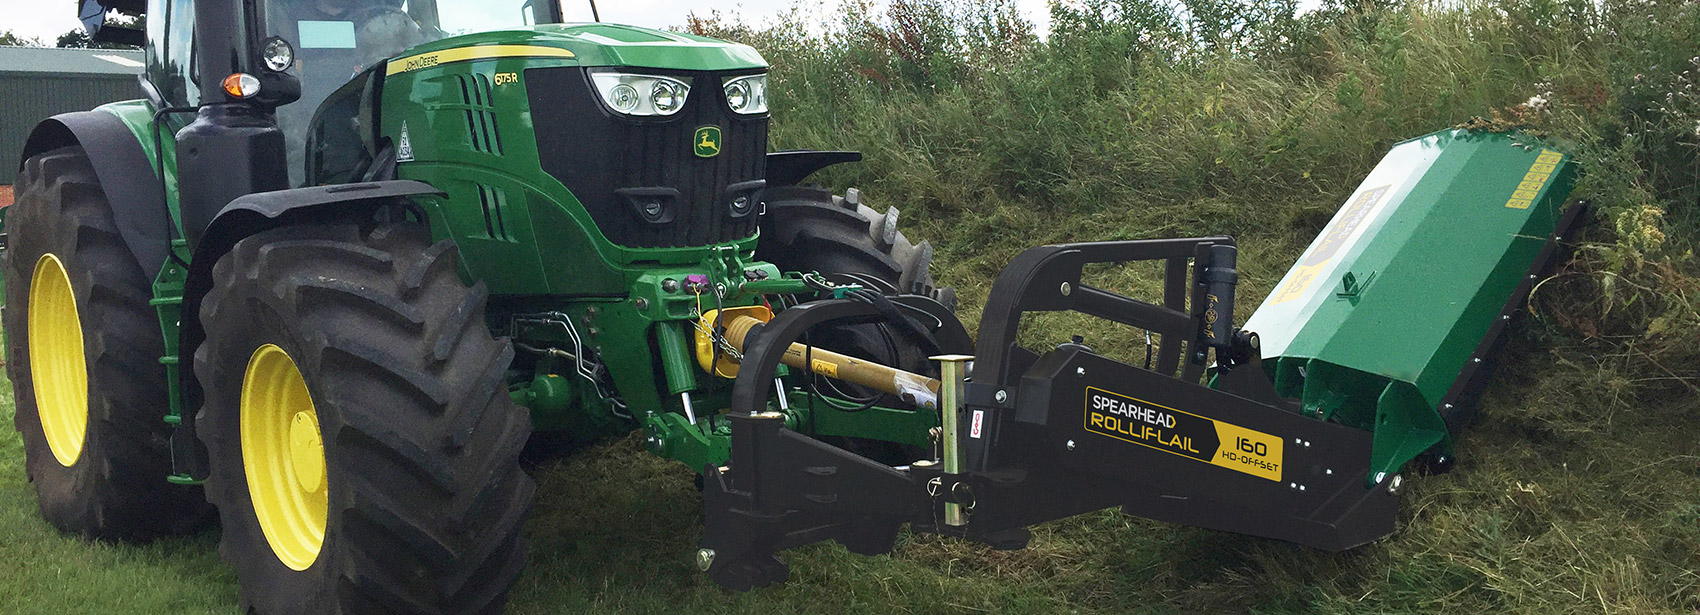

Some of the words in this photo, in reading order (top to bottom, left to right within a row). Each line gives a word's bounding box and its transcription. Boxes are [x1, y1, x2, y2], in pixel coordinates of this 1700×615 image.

[405, 59, 419, 70] JOHN
[420, 55, 438, 67] DEERE
[1093, 395, 1176, 429] SPEARHEAD
[1091, 412, 1199, 454] ROLLIFLAIL
[1236, 436, 1267, 457] 160
[1222, 450, 1278, 472] HD-OFFSET
